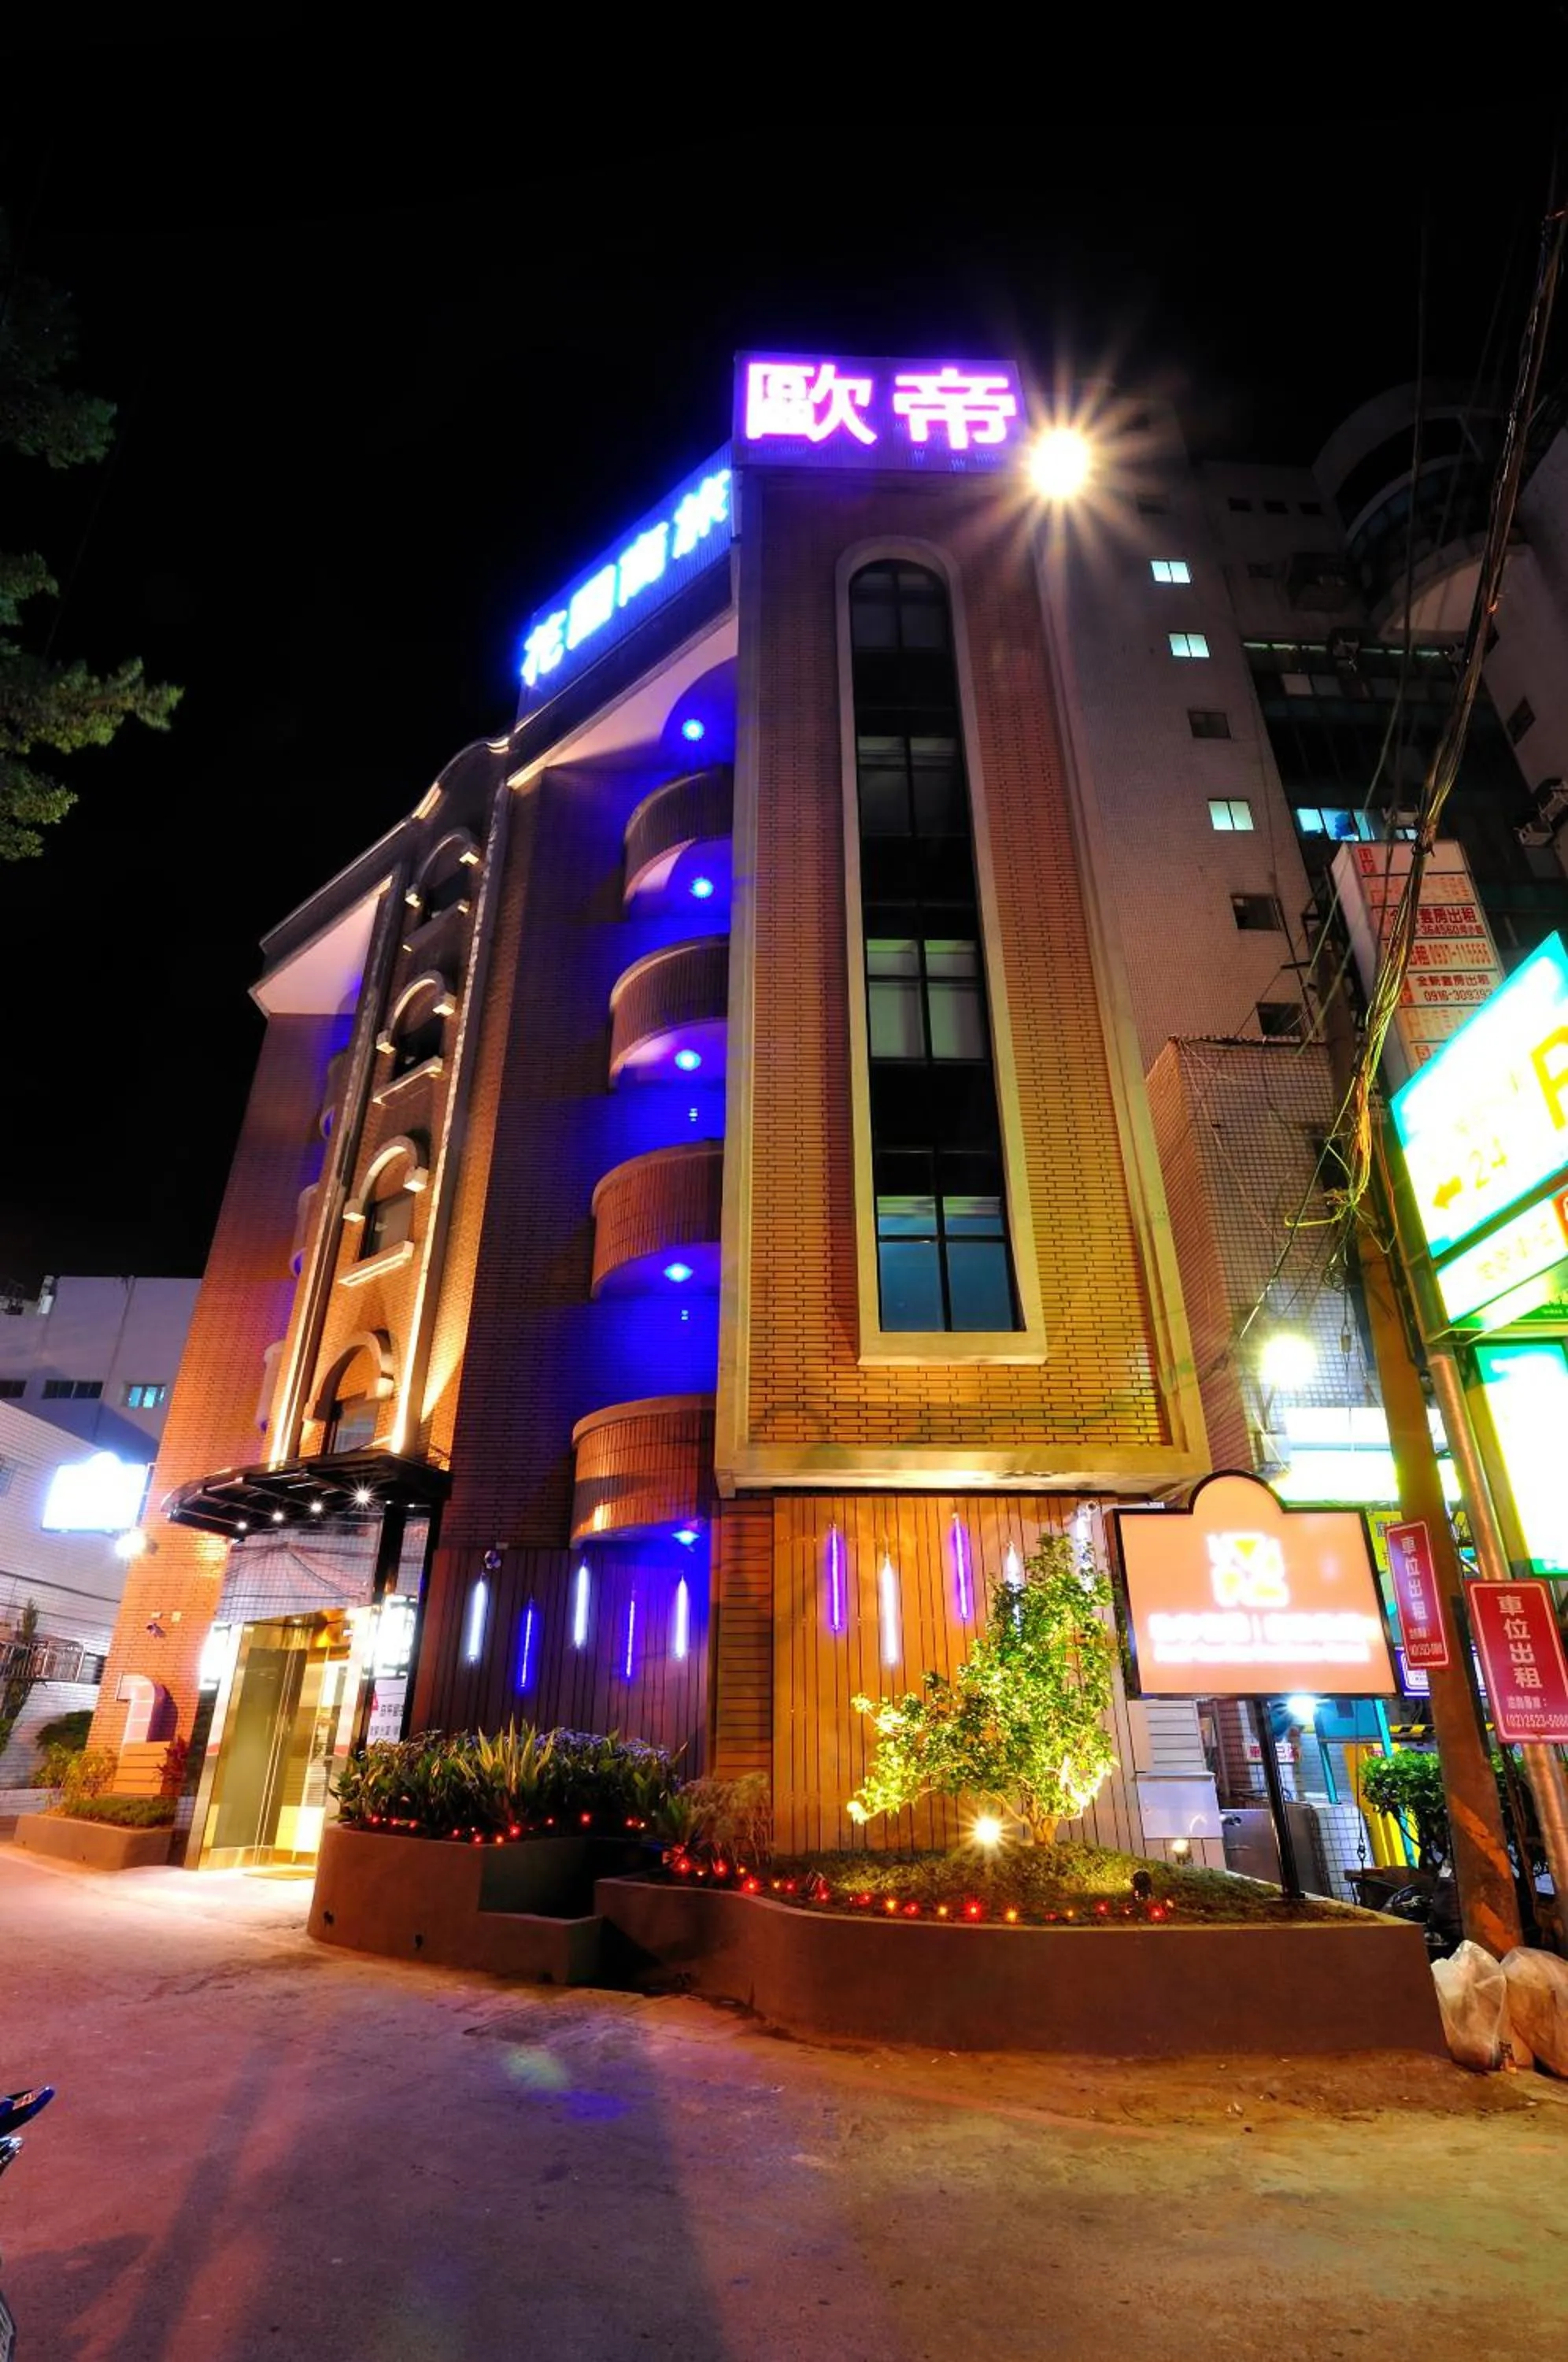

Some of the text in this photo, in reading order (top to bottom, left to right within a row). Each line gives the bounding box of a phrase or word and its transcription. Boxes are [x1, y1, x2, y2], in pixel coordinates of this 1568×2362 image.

[745, 363, 1017, 450] 歐帝
[1401, 1536, 1429, 1621] 車位出租
[1497, 1595, 1543, 1689] 車位出租
